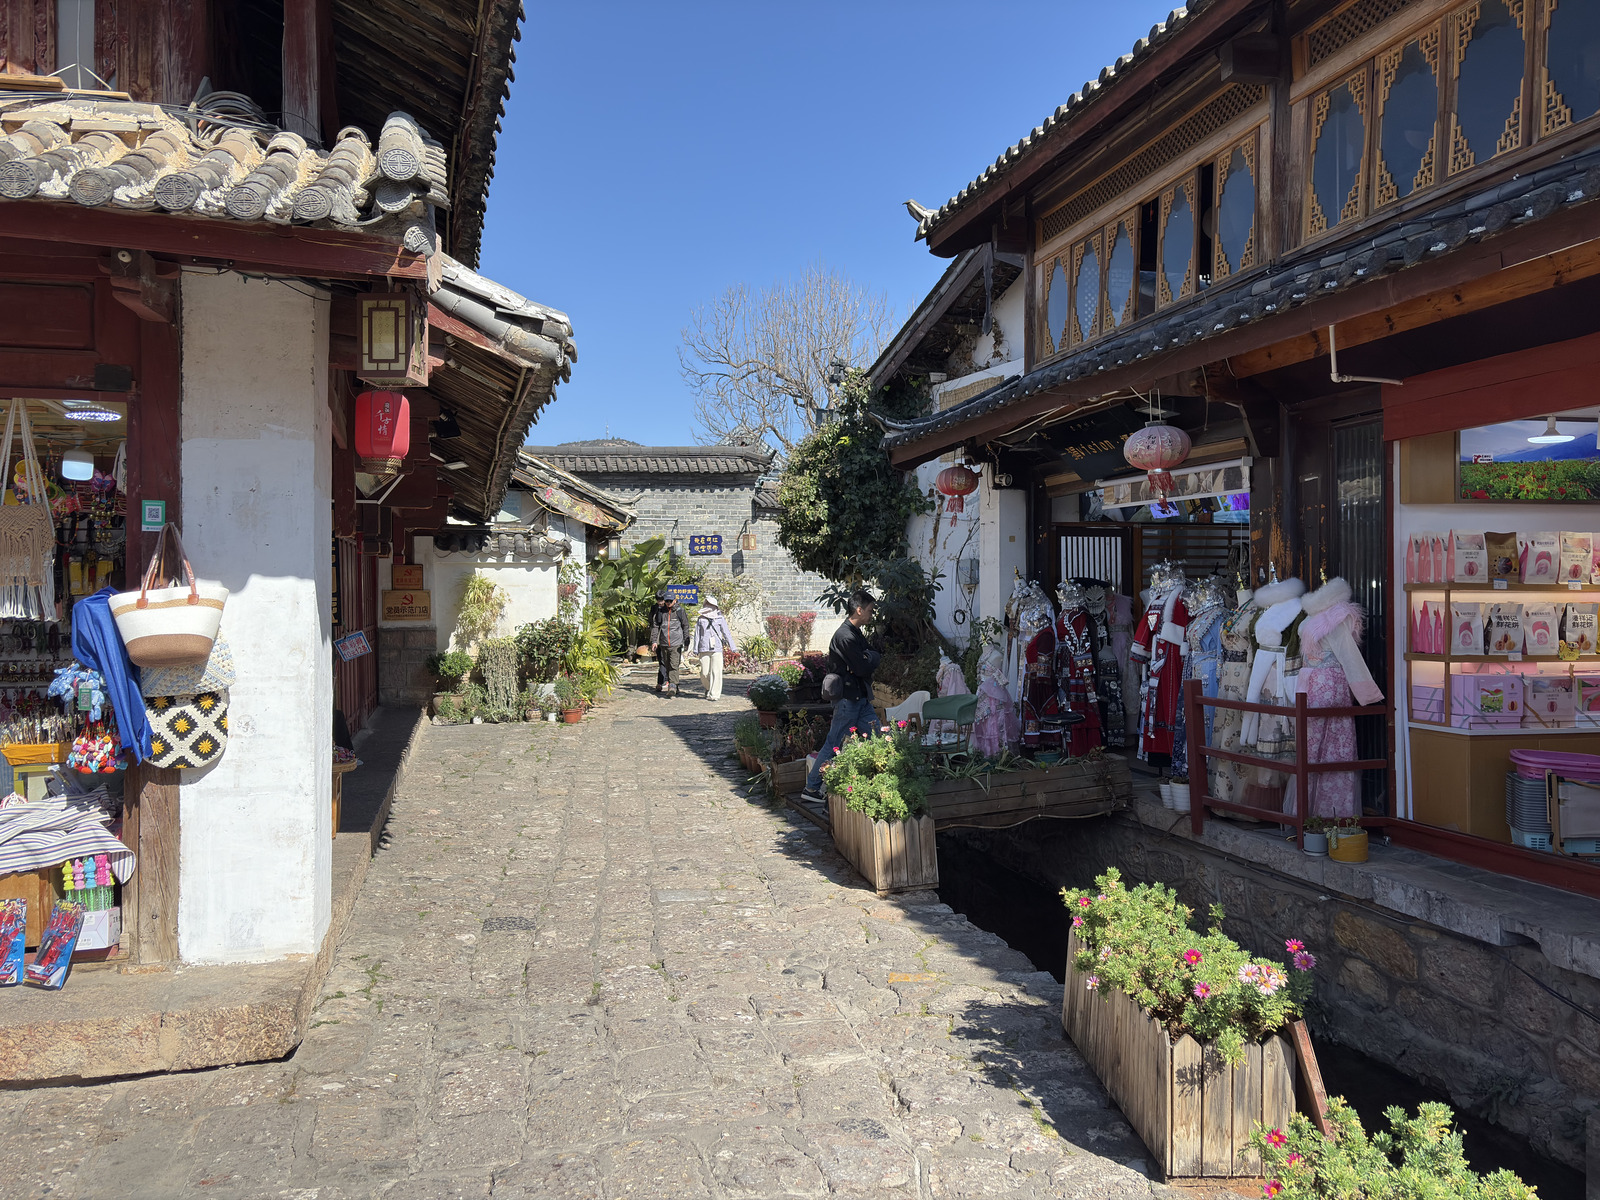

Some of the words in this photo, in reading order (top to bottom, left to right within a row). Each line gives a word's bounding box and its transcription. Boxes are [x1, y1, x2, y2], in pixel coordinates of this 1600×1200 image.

[375, 409, 392, 436] 千古情
[386, 606, 429, 614] 党员示范门店
